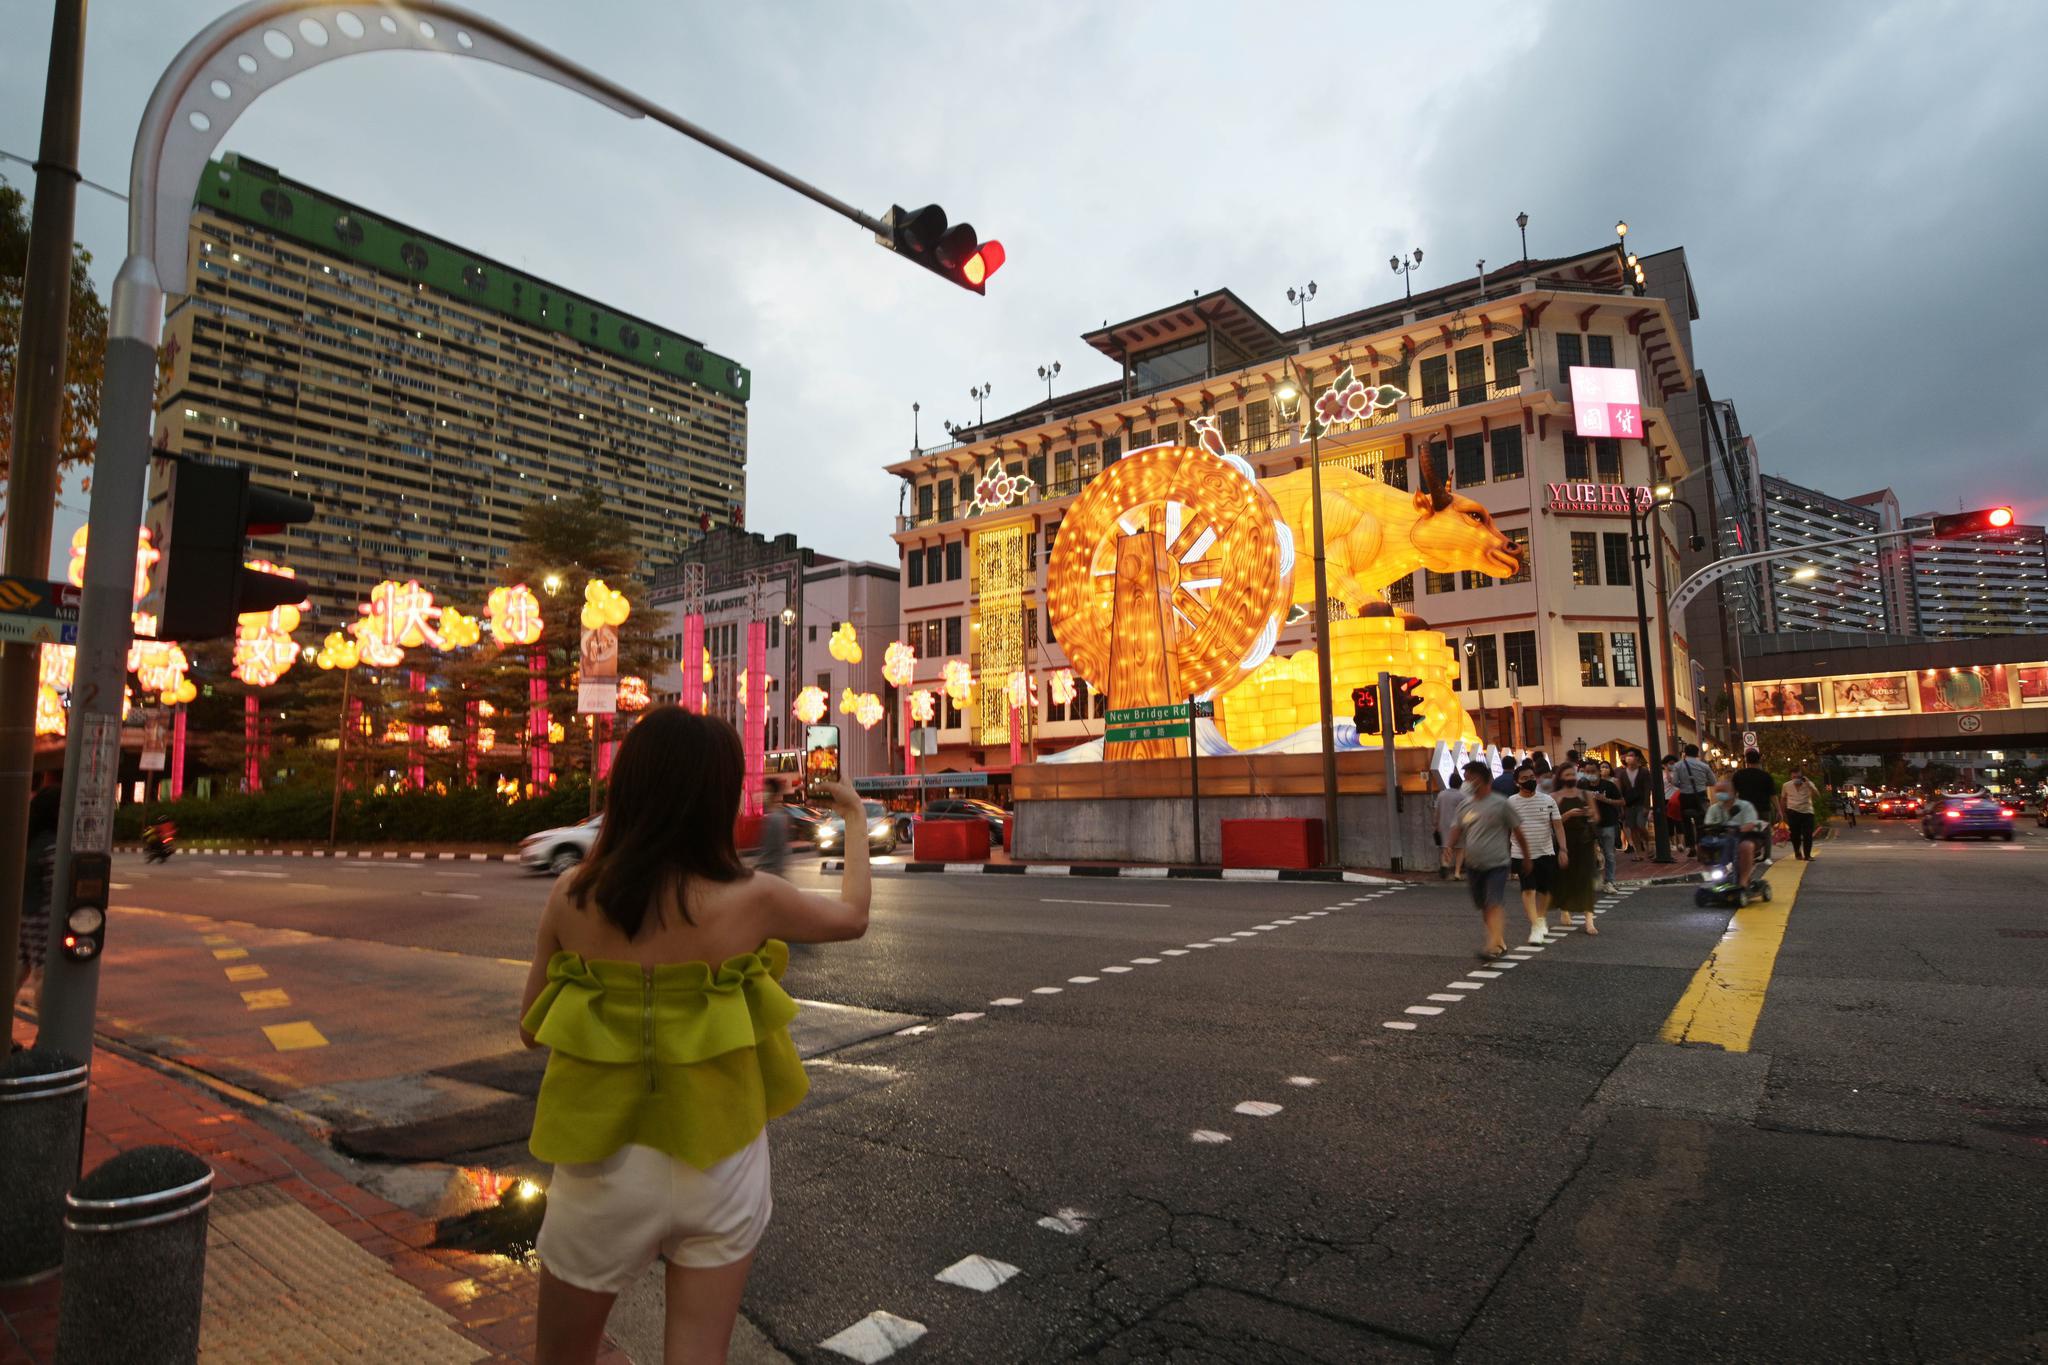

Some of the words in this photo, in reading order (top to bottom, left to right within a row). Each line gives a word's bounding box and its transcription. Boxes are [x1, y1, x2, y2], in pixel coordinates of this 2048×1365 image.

[1547, 482, 1597, 502] YUE
[1599, 484, 1653, 504] HWA
[1550, 502, 1598, 511] CHINESE
[1601, 503, 1650, 513] PRODC
[1358, 691, 1374, 706] 25
[1872, 688, 1899, 696] GUESS
[1109, 712, 1130, 721] New
[1134, 708, 1169, 720] Bridge
[1173, 706, 1186, 716] Rd
[871, 779, 901, 789] Singapore
[923, 776, 942, 785] World
